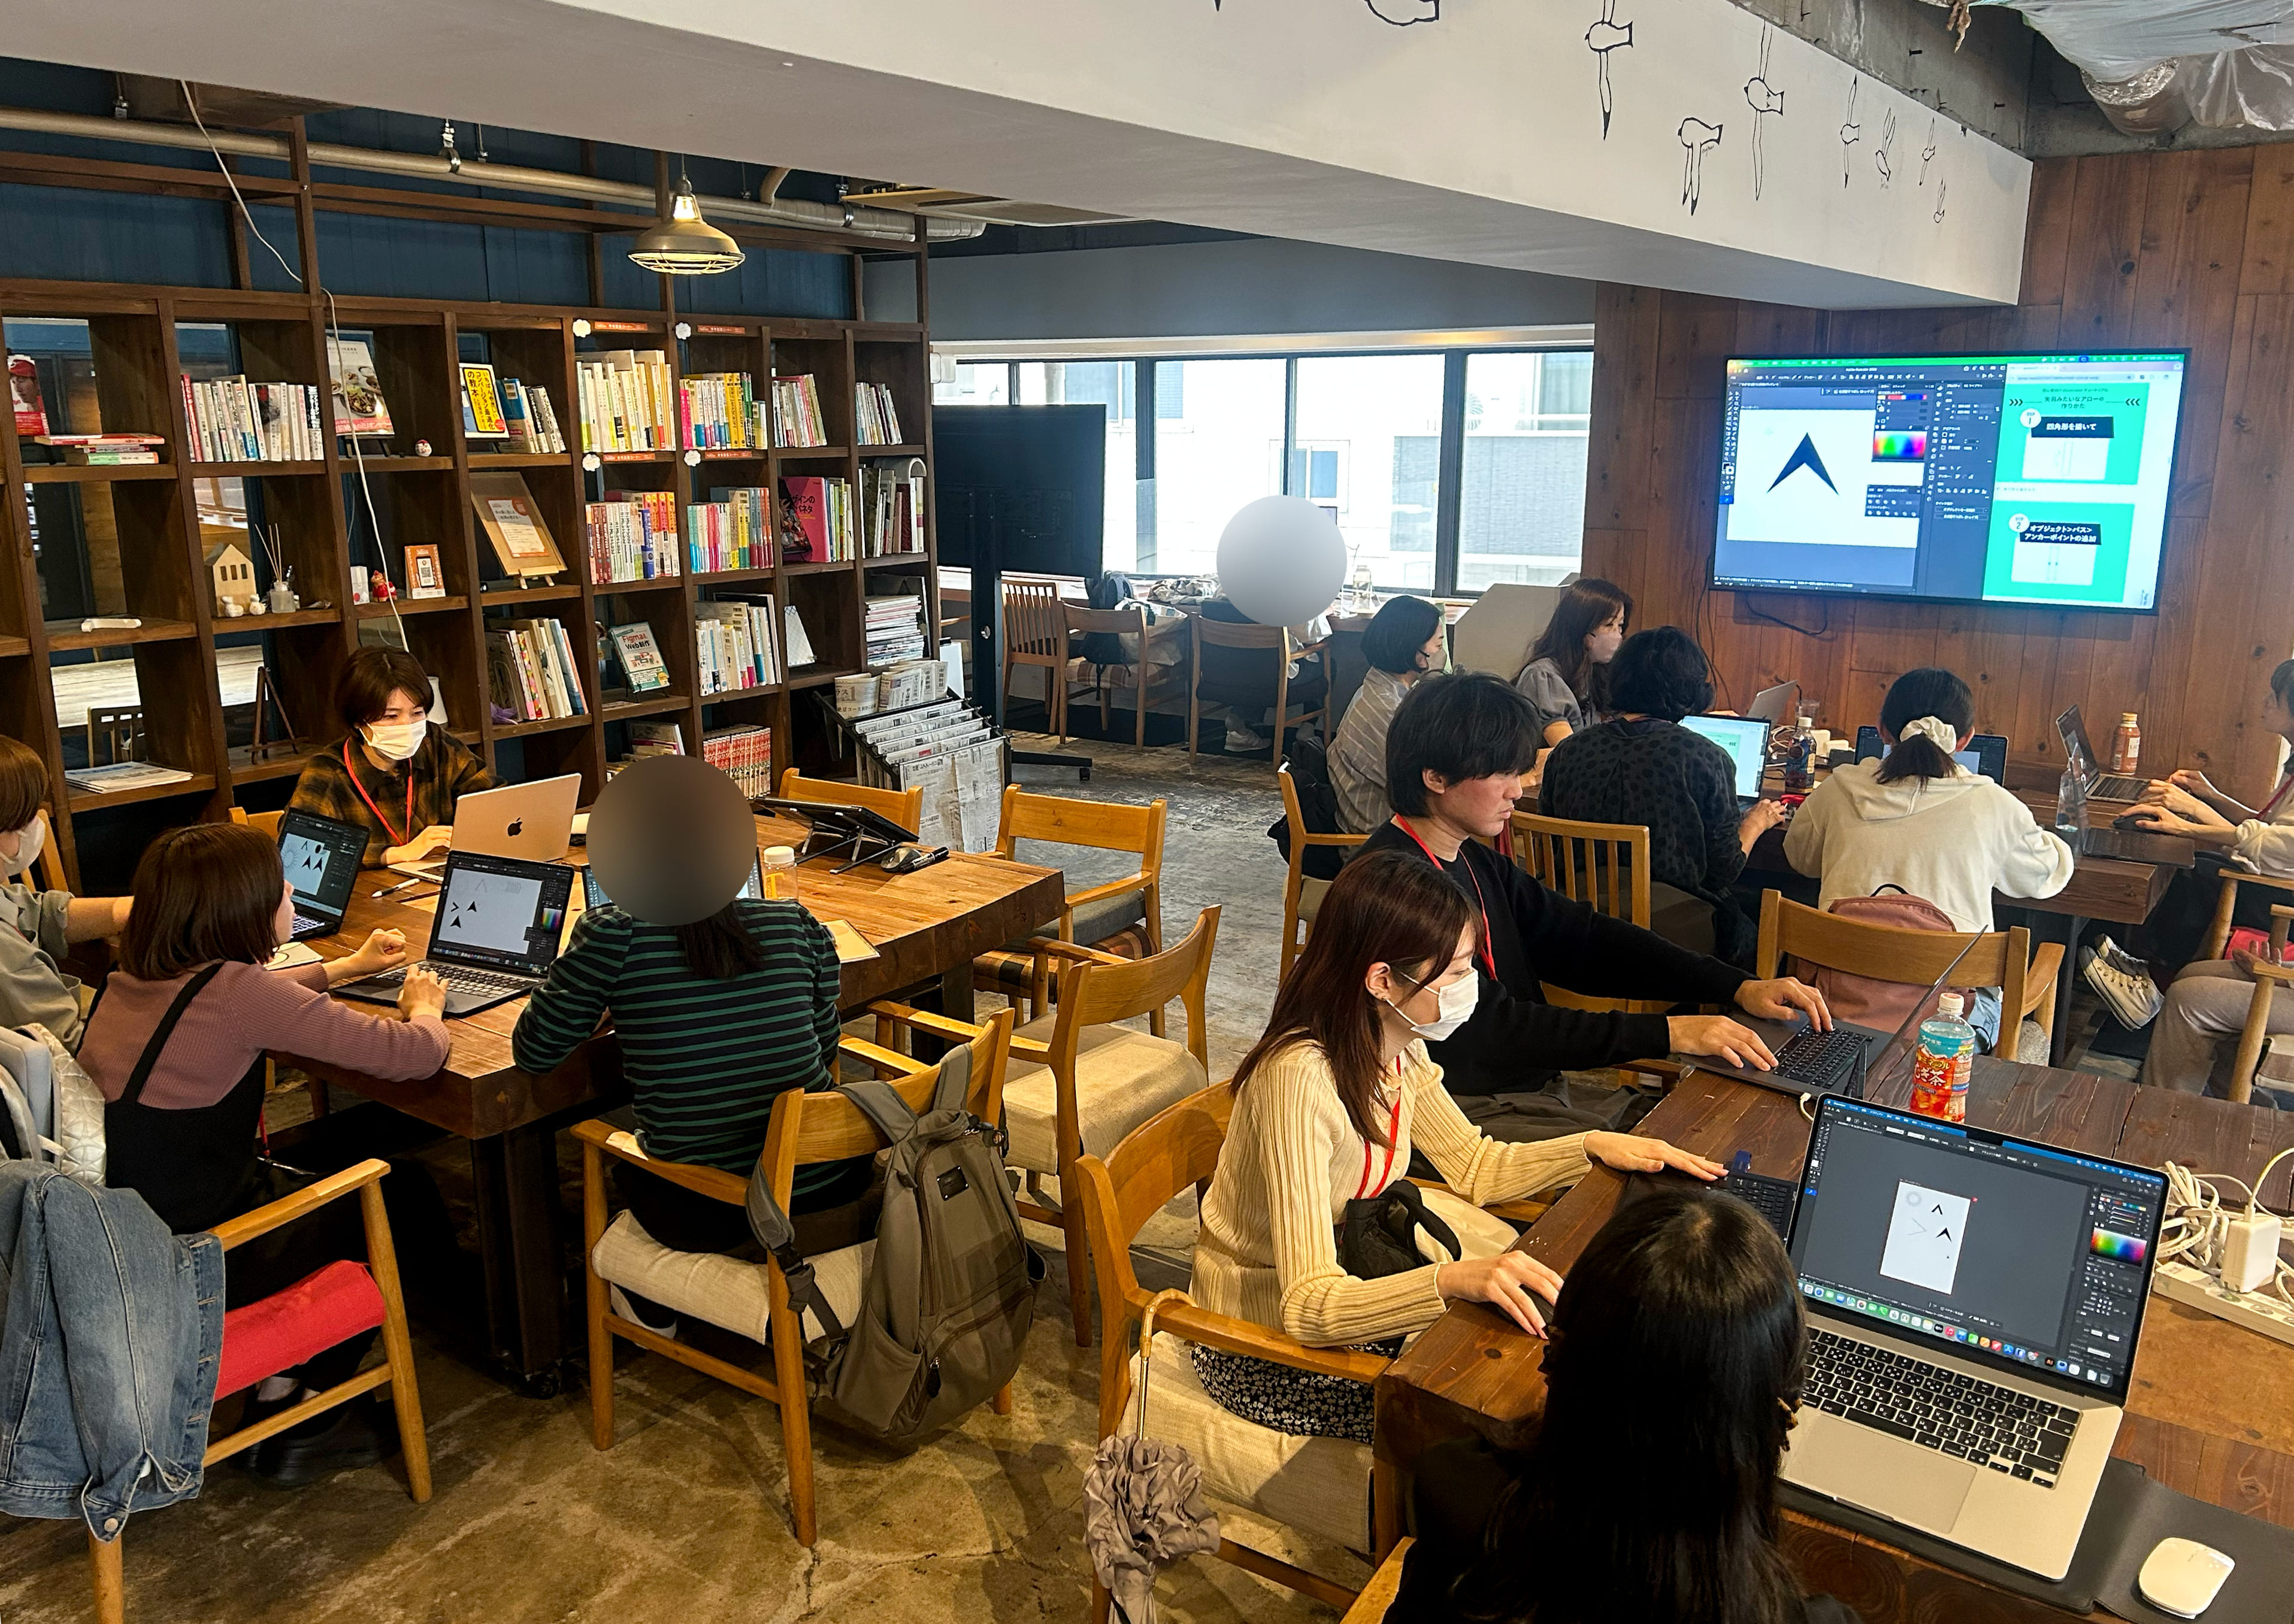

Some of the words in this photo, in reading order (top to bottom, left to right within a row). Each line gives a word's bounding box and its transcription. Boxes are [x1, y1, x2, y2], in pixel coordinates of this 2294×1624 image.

[467, 371, 479, 396] の教本
[2045, 422, 2097, 431] 四角形を描いて
[2024, 533, 2096, 543] アンカーポイントの追加
